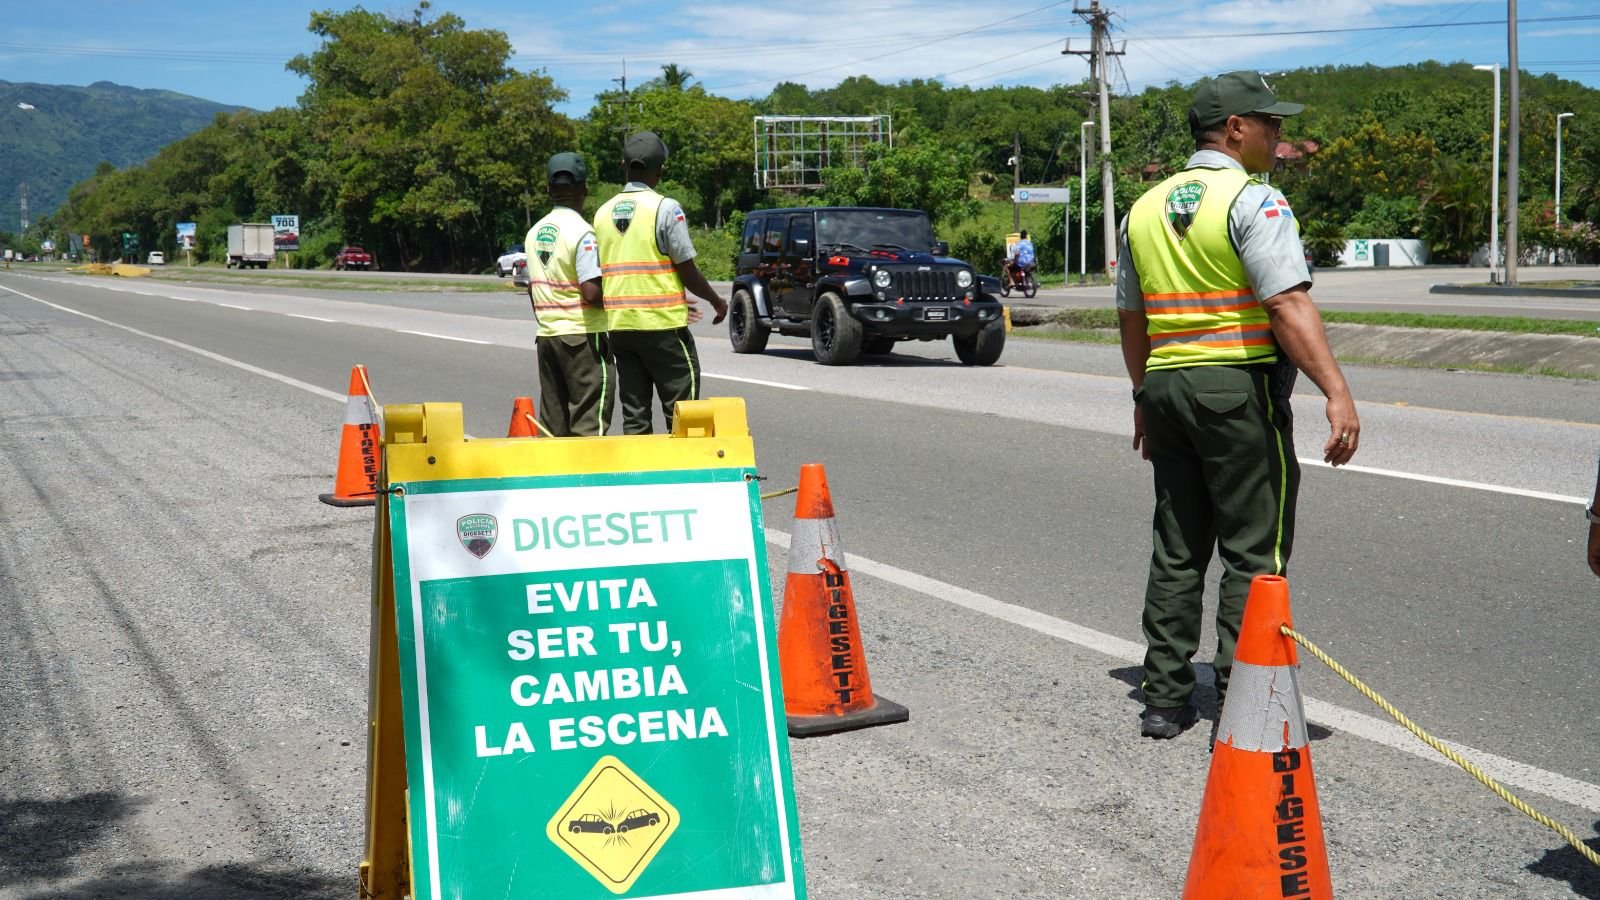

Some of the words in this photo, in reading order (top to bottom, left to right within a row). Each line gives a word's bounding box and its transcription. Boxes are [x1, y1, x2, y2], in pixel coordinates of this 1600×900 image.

[1174, 186, 1201, 197] POLICIA
[461, 518, 493, 526] POLICIA
[512, 509, 698, 551] DIGESETT
[526, 577, 658, 614] EVITA
[507, 625, 598, 661] SER
[608, 620, 682, 658] TU,
[825, 573, 854, 704] DIGESETT
[510, 664, 689, 707] CAMBIA
[474, 722, 536, 758] LA
[548, 706, 729, 750] ESCENA
[1273, 749, 1311, 900] DIGESE
